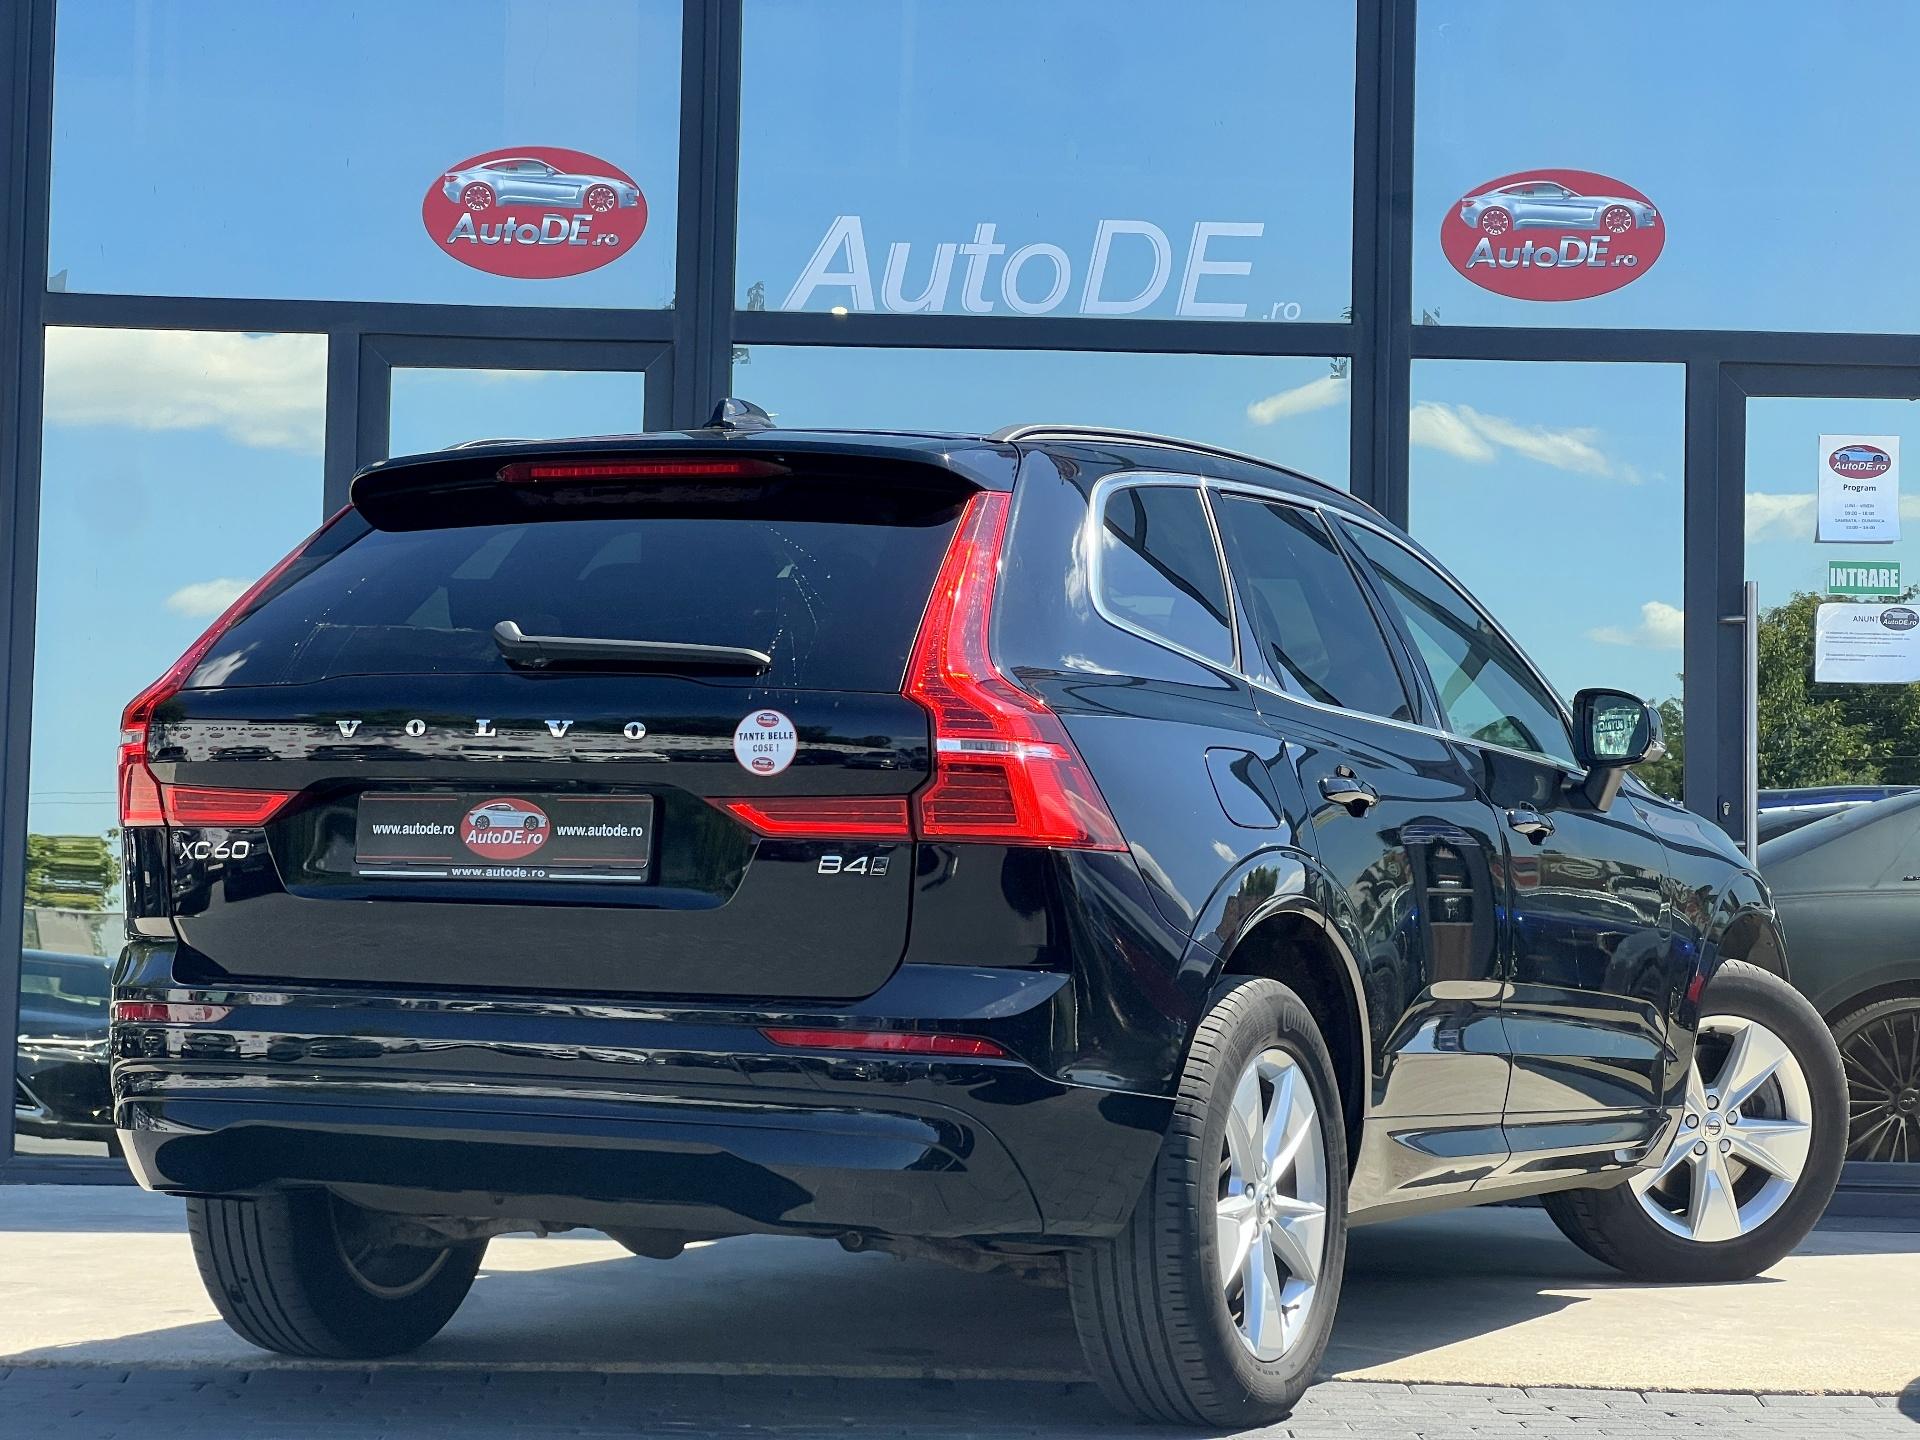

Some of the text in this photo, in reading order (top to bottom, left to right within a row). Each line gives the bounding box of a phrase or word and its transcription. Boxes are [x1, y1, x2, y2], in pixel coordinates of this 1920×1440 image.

[1834, 461, 1887, 471] AutoDE.ro
[1843, 484, 1877, 492] Program
[1830, 567, 1899, 588] INTRARE
[336, 719, 647, 740] VOLVO
[739, 731, 794, 741] TANTE BELLE
[752, 743, 774, 753] COSE
[372, 822, 455, 835] www.autode.ro
[556, 823, 643, 837] www.autode.ro
[465, 829, 543, 844] AutoDE.ro
[179, 840, 249, 860] XC60
[817, 855, 868, 875] B4
[451, 866, 546, 878] www.autode.ro
